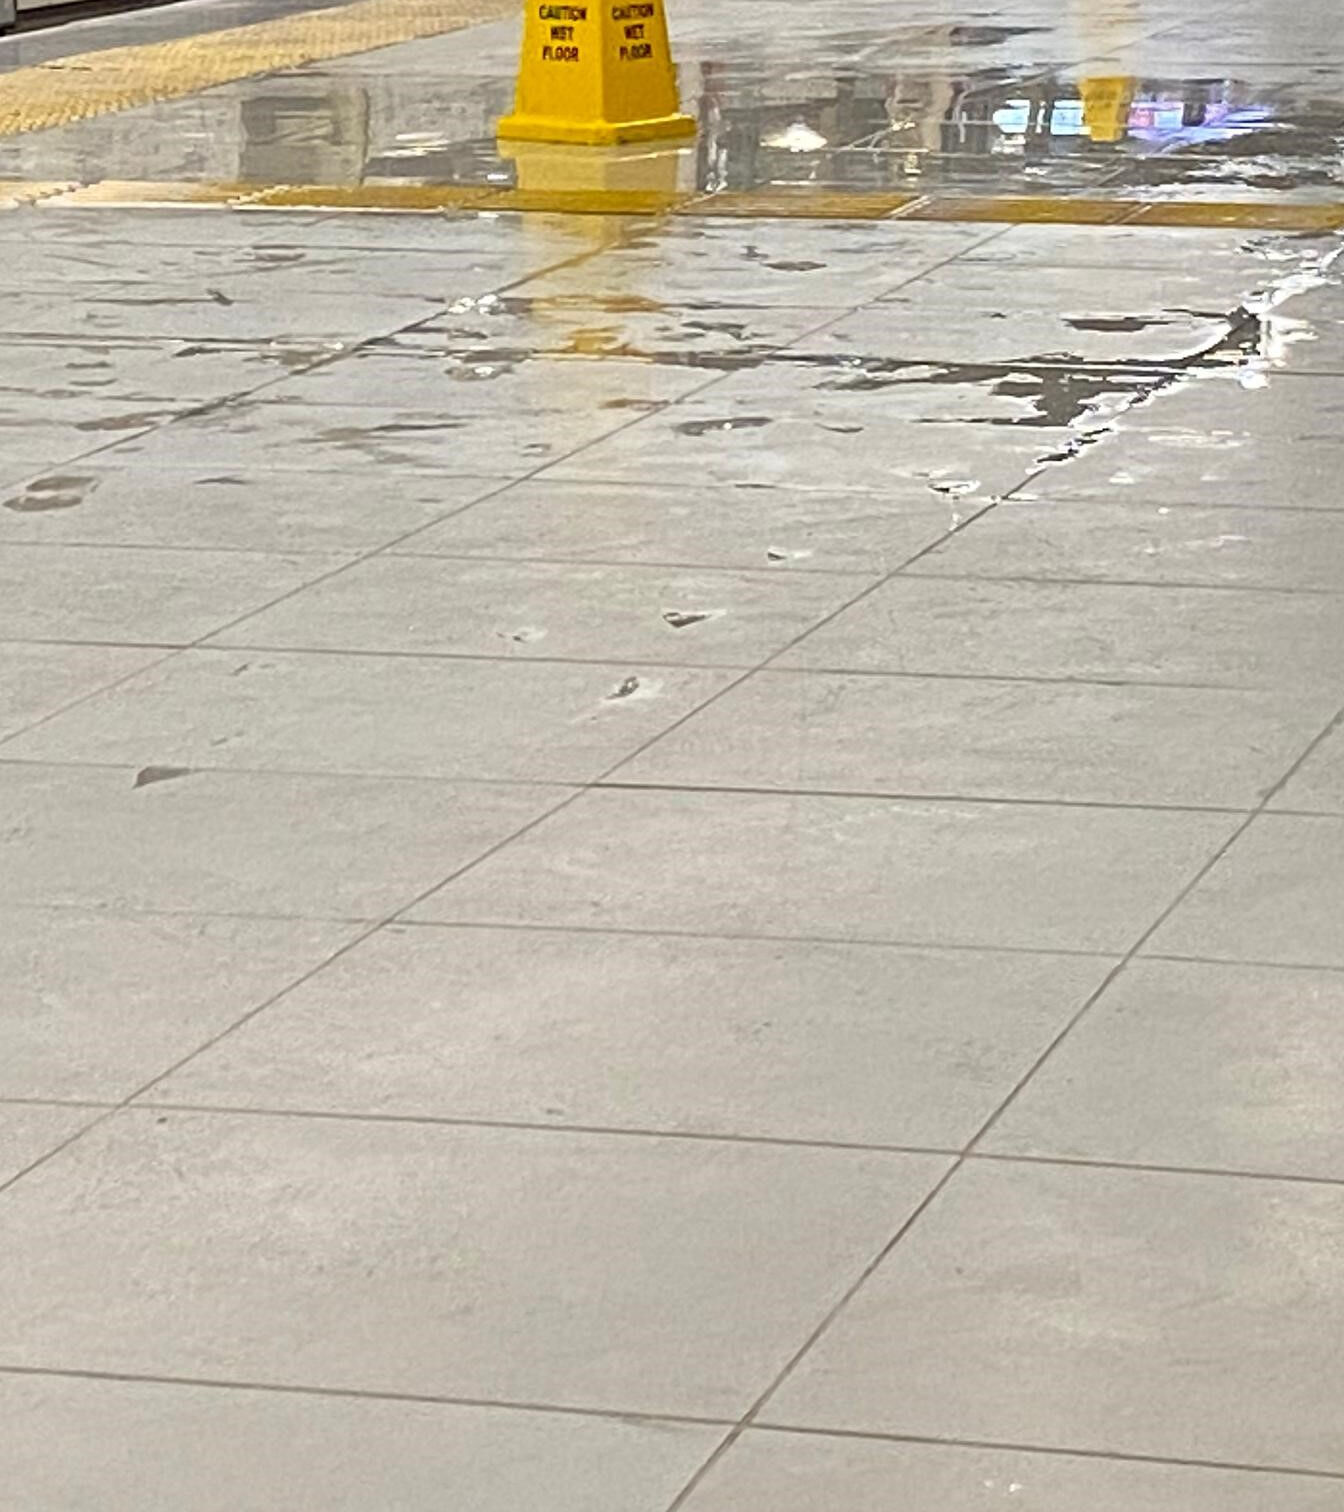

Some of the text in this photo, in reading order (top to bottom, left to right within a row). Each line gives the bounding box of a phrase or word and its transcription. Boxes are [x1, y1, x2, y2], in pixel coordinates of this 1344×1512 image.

[539, 5, 587, 21] CAUTION
[612, 3, 655, 21] CAUTION
[550, 26, 574, 41] WET
[624, 24, 645, 39] WET
[542, 46, 579, 62] FLOOR
[619, 44, 653, 61] FLOOR
